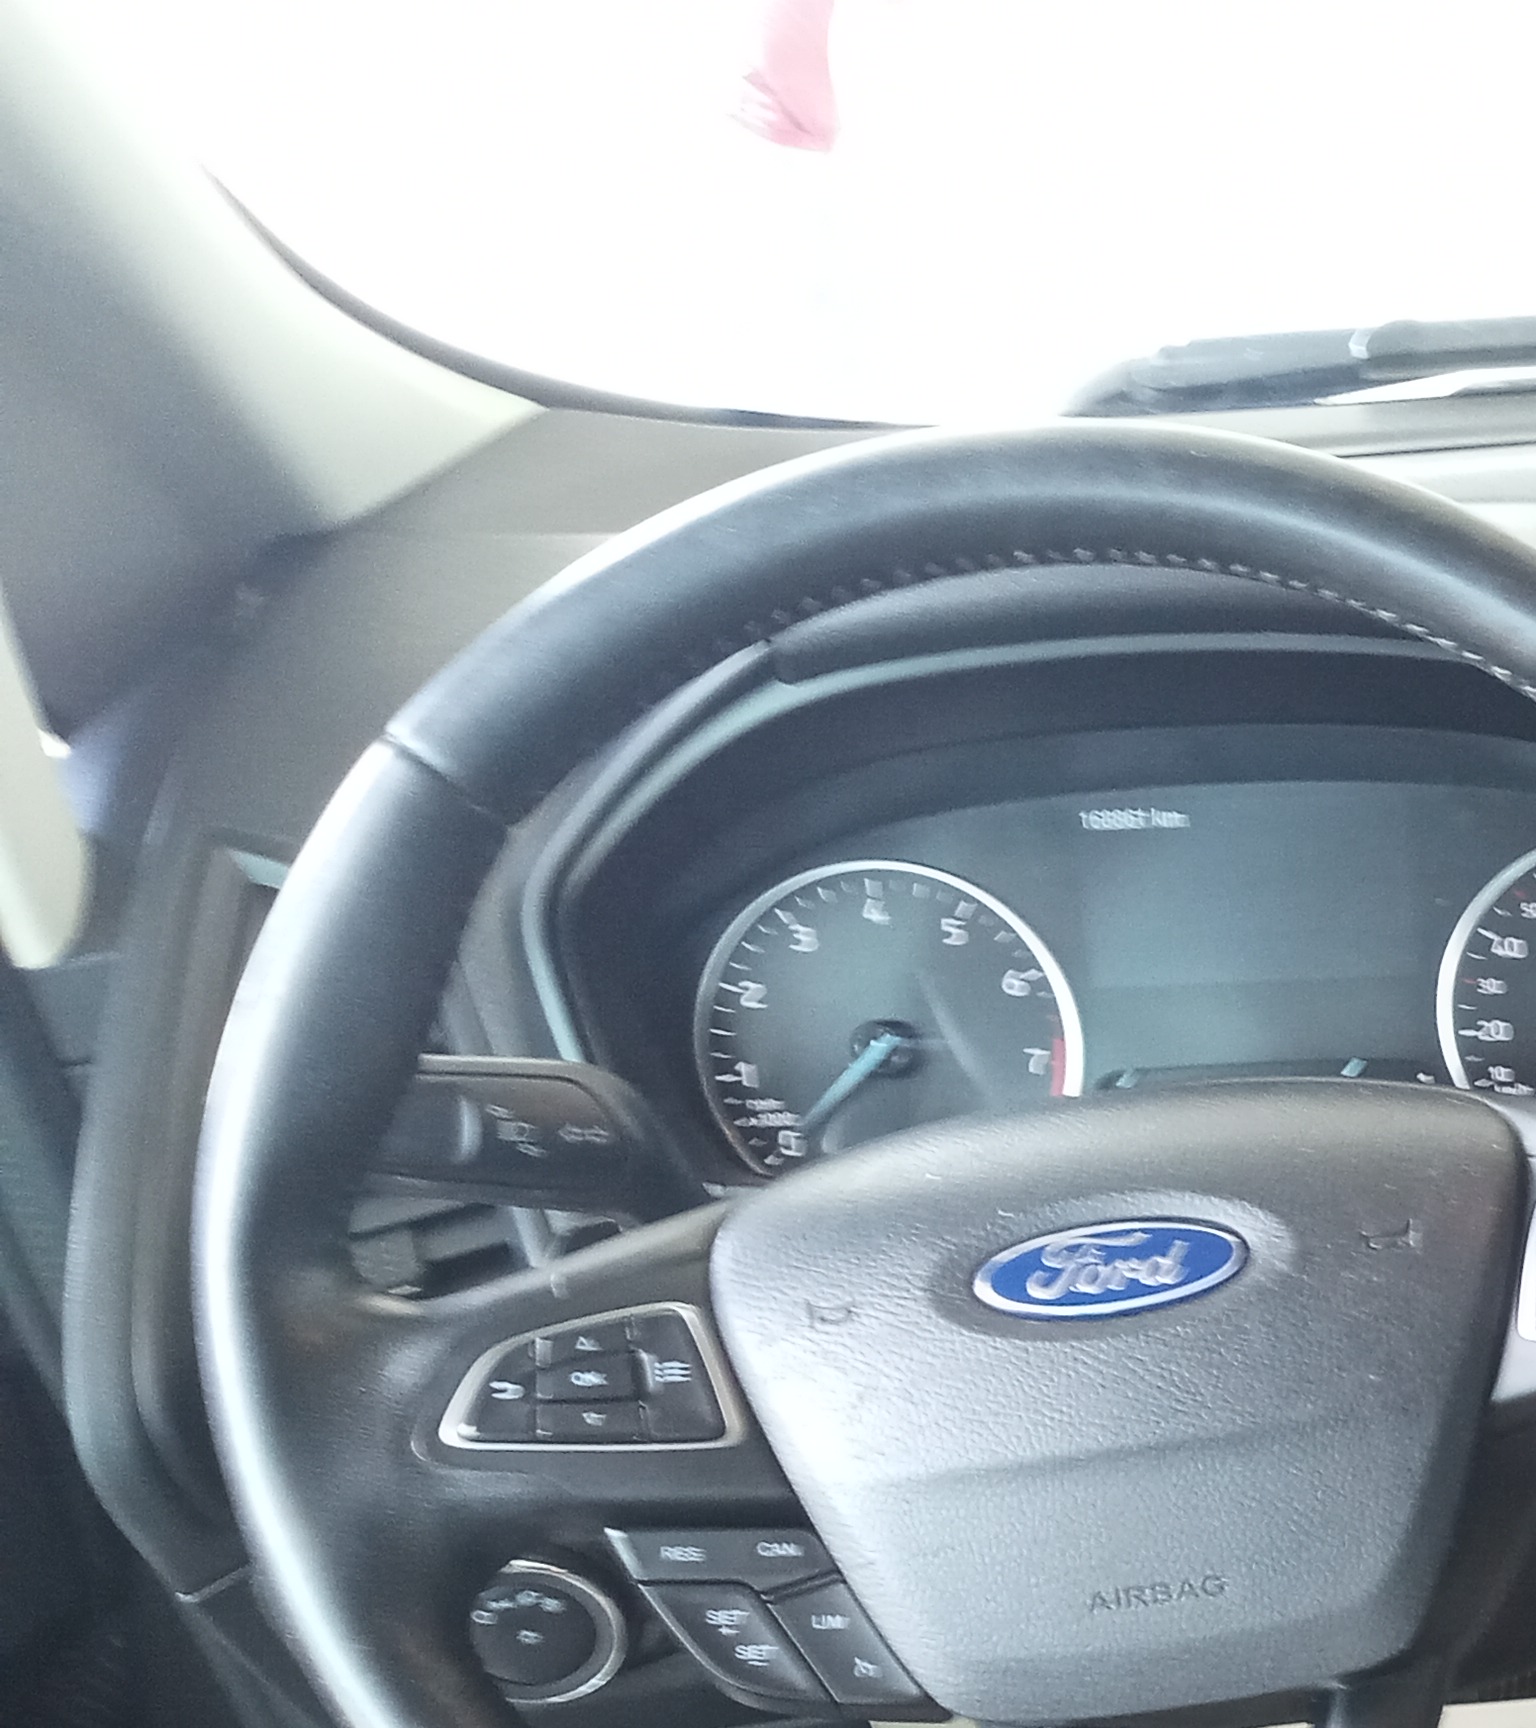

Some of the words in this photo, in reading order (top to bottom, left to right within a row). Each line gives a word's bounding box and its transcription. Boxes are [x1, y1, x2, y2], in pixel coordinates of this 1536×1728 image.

[789, 923, 819, 953] 3
[941, 917, 970, 946] 5
[739, 980, 768, 1008] 2
[1001, 970, 1032, 997] 6
[1476, 1019, 1515, 1041] 20
[1487, 1065, 1516, 1082] 10
[1026, 1231, 1190, 1300] Ford
[756, 1541, 804, 1558] CAN
[1088, 1574, 1228, 1613] AIRBAG
[705, 1609, 750, 1625] SET
[734, 1644, 780, 1660] SET
